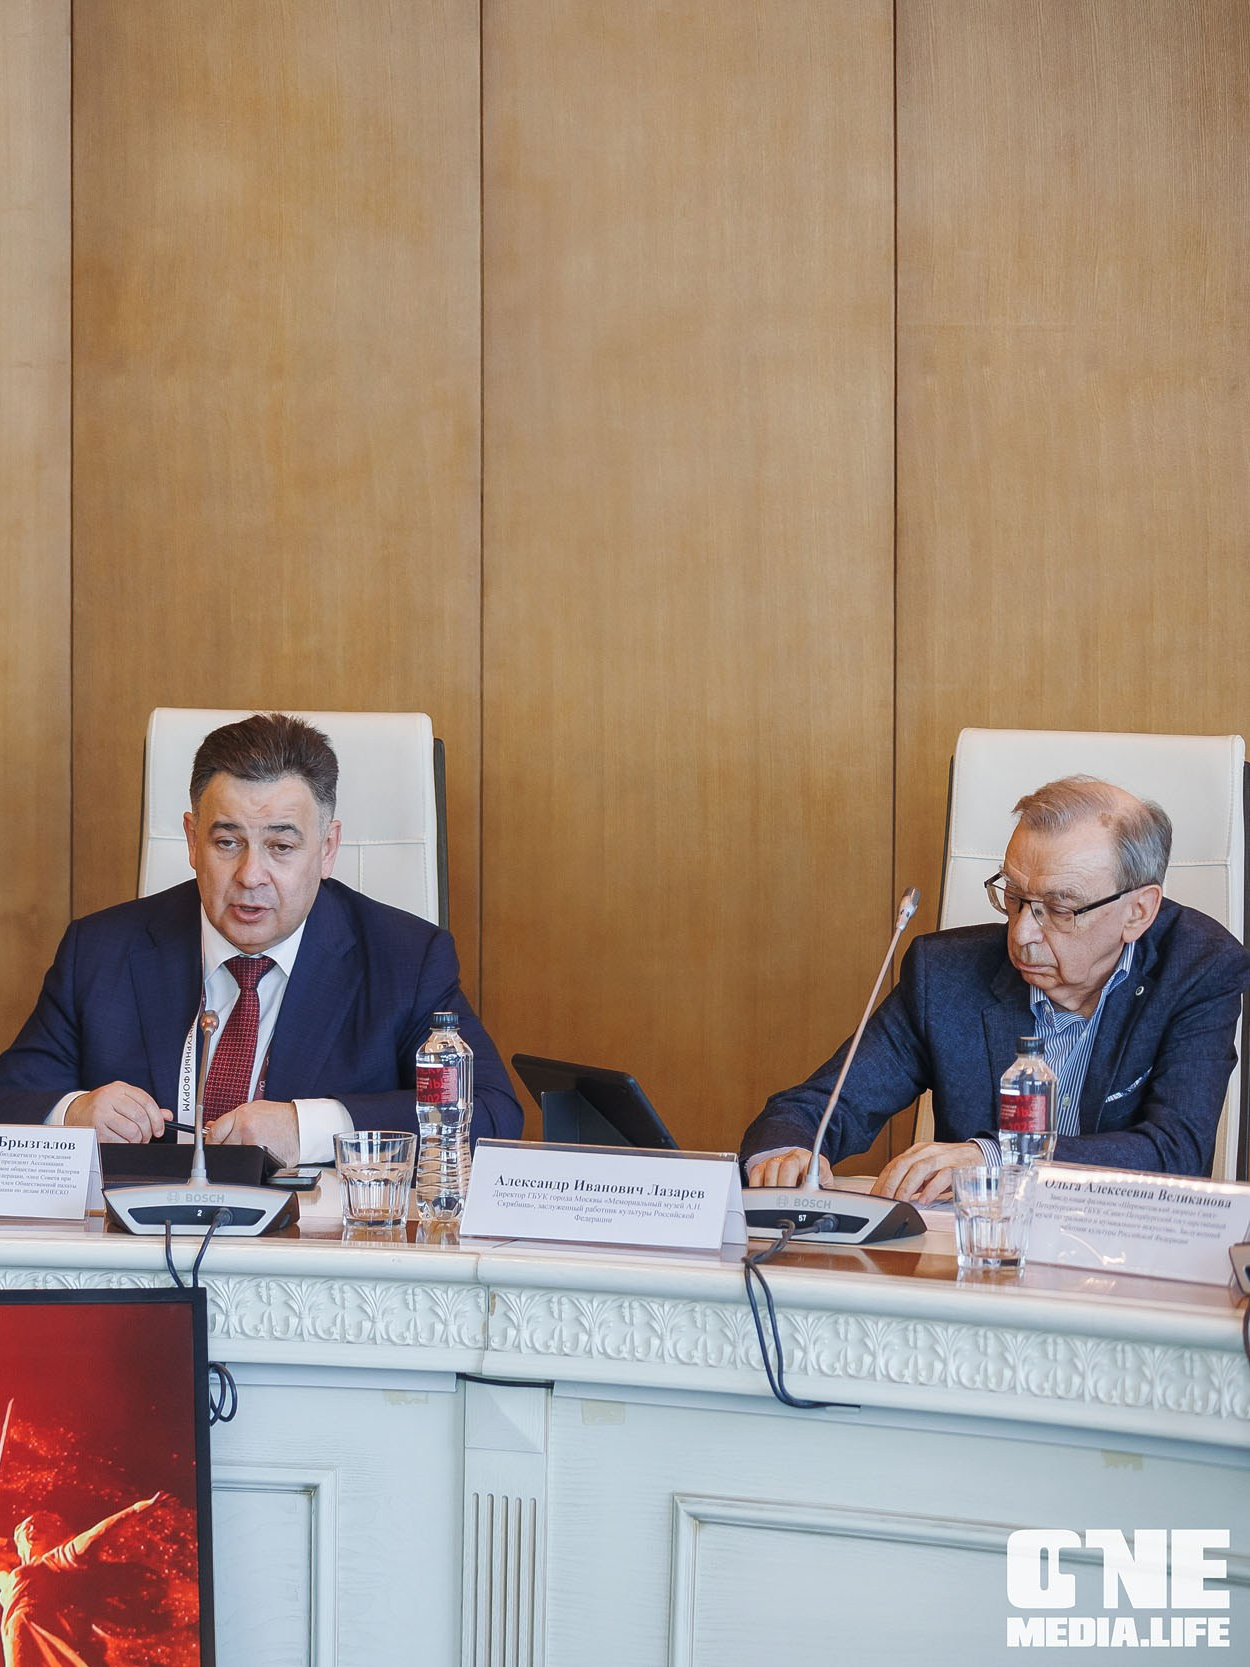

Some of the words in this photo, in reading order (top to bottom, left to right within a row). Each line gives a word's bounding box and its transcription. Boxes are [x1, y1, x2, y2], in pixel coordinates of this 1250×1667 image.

[182, 1075, 191, 1112] ФОРУМ
[494, 1174, 570, 1193] Александр
[573, 1179, 644, 1195] Иванович
[647, 1183, 705, 1201] Лазарев
[1045, 1179, 1082, 1192] Ольга
[1084, 1181, 1154, 1200] Алексеевна
[1158, 1189, 1232, 1209] Великанова
[185, 1193, 225, 1203] BOSCH
[492, 1190, 526, 1200] Директор
[527, 1192, 548, 1200] ГБУК
[573, 1195, 603, 1203] Москвы
[664, 1202, 685, 1210] музей
[794, 1198, 831, 1209] BOSCH
[538, 1203, 584, 1212] заслуженный
[584, 1205, 617, 1214] работник
[619, 1208, 652, 1218] культуры
[653, 1209, 695, 1220] Российской
[798, 1214, 807, 1222] 57
